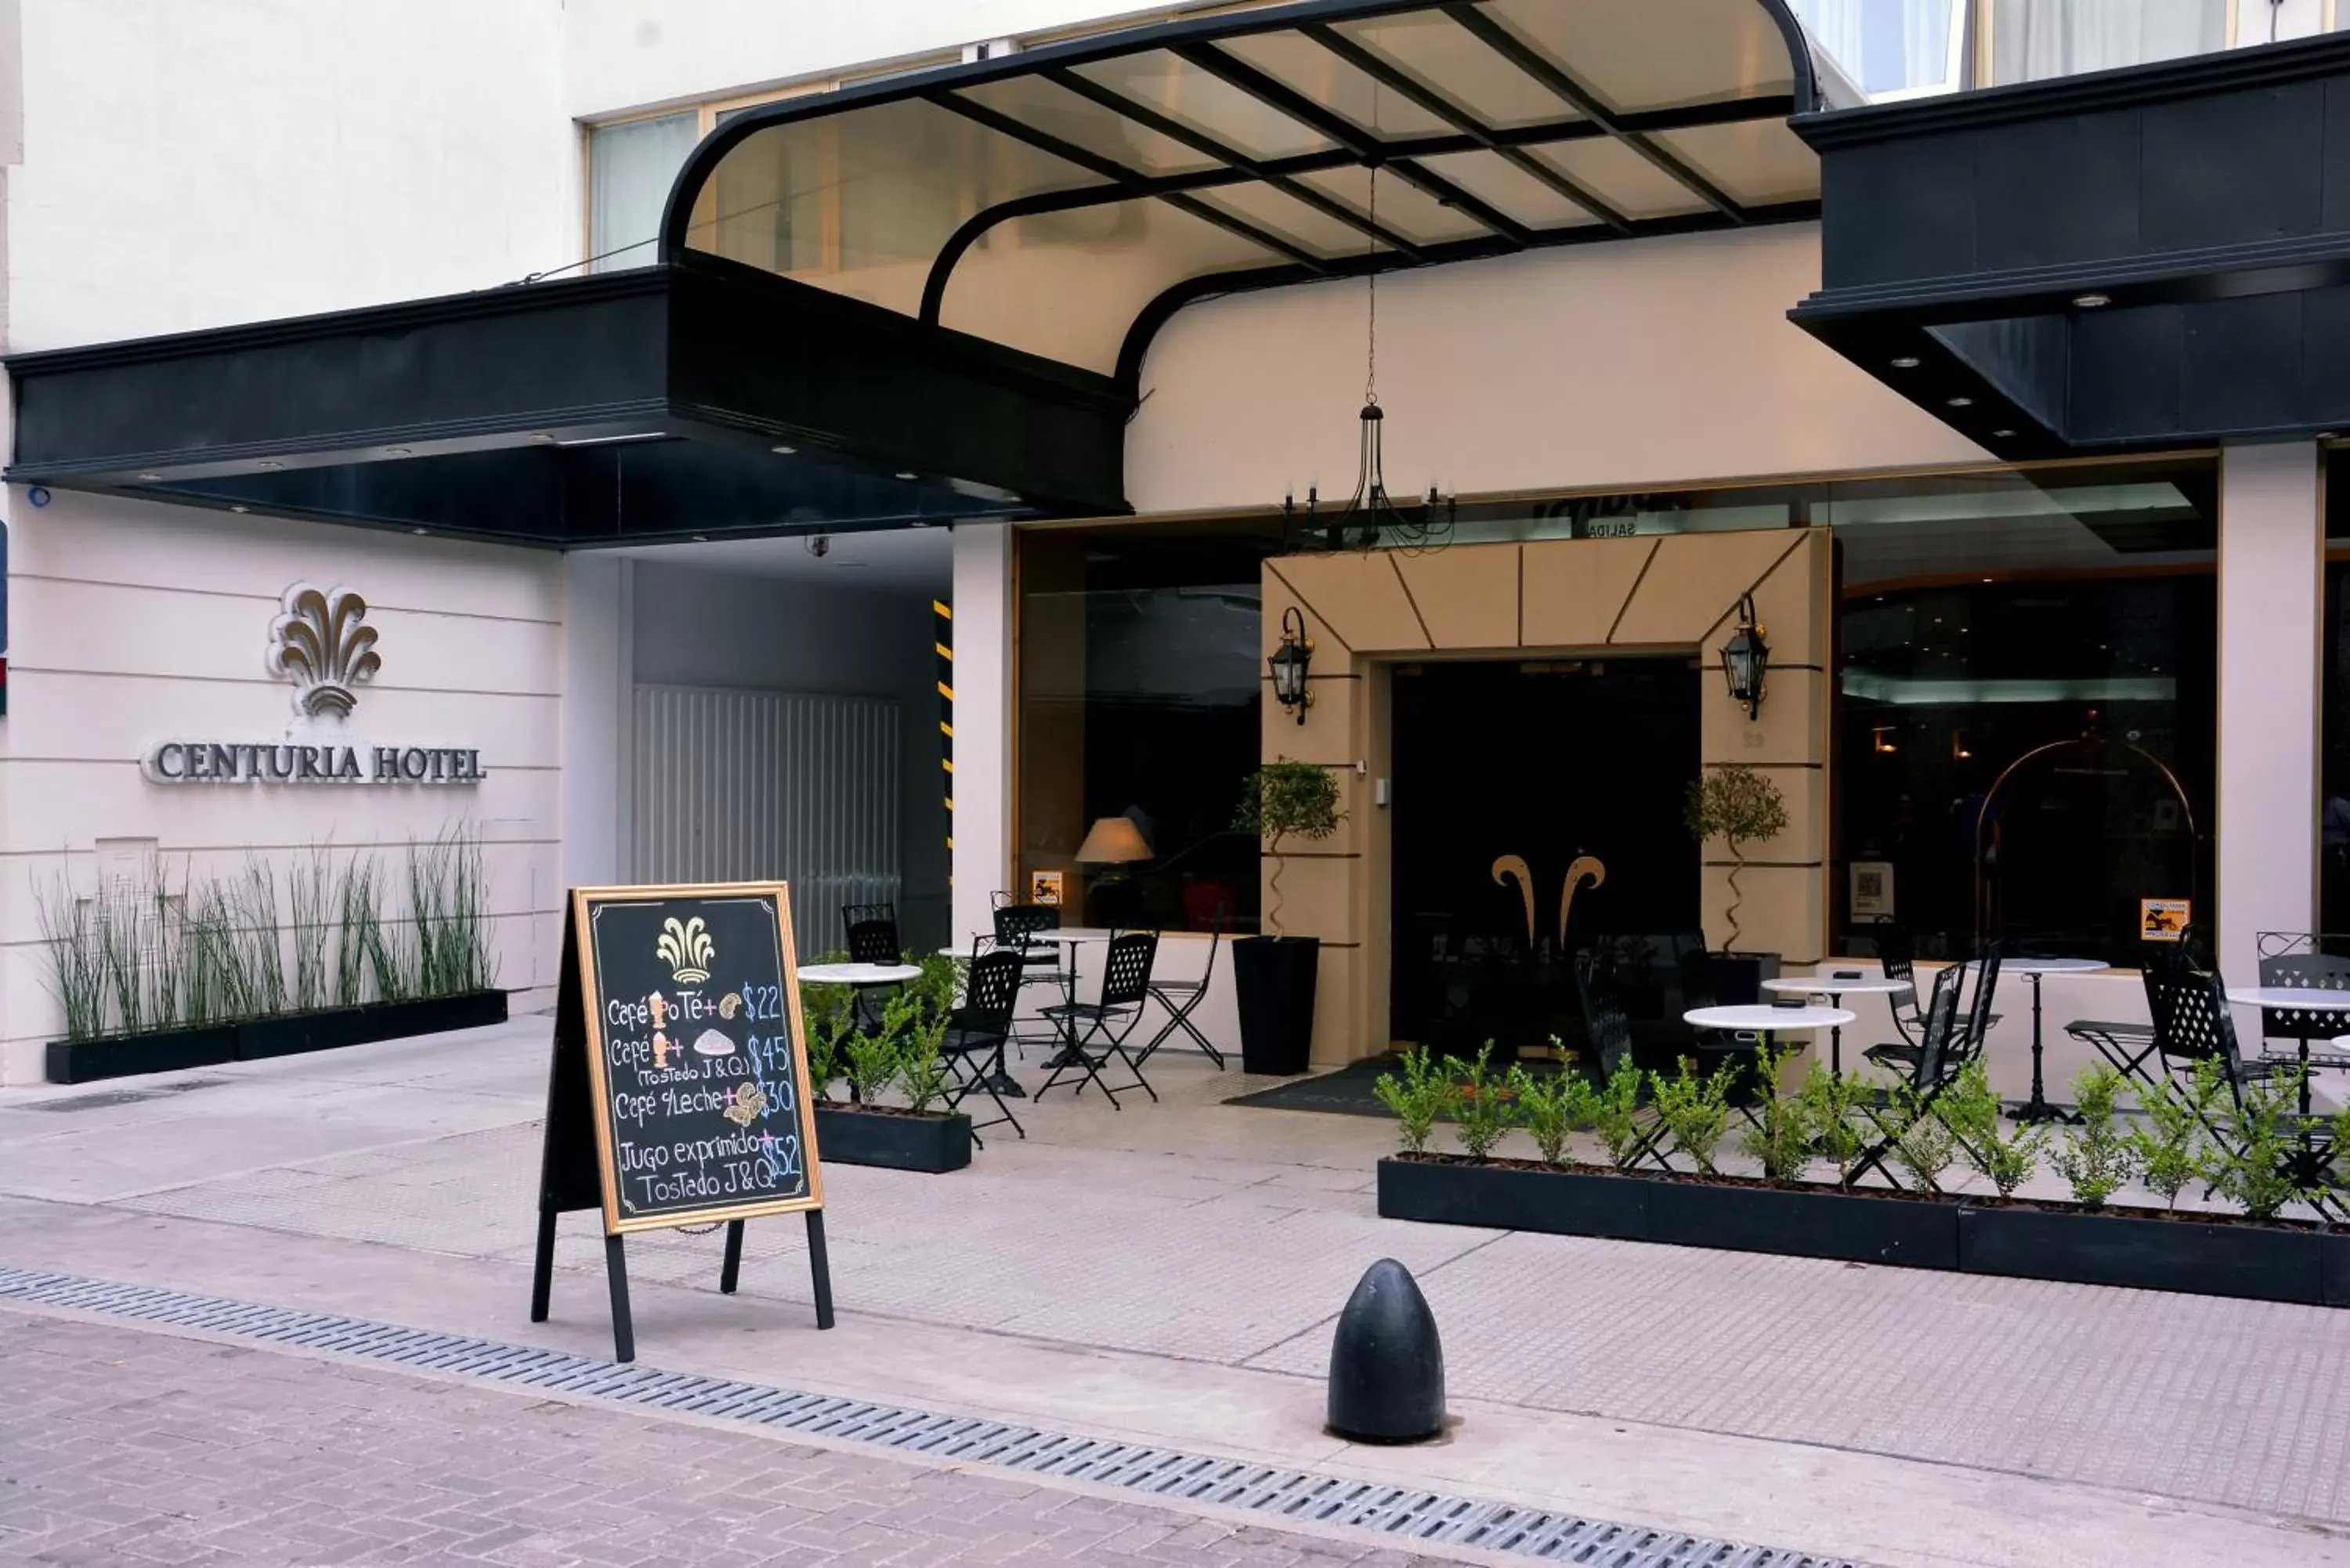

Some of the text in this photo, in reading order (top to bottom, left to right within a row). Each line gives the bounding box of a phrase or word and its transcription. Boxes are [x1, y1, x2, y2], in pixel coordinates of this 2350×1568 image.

[157, 743, 487, 780] CENTURIA HOTEL
[607, 995, 649, 1031] Café
[742, 981, 780, 1023] $22
[610, 1033, 650, 1072] Café
[748, 1035, 787, 1080] $45
[615, 1089, 656, 1128] Café
[762, 1135, 803, 1180] $52
